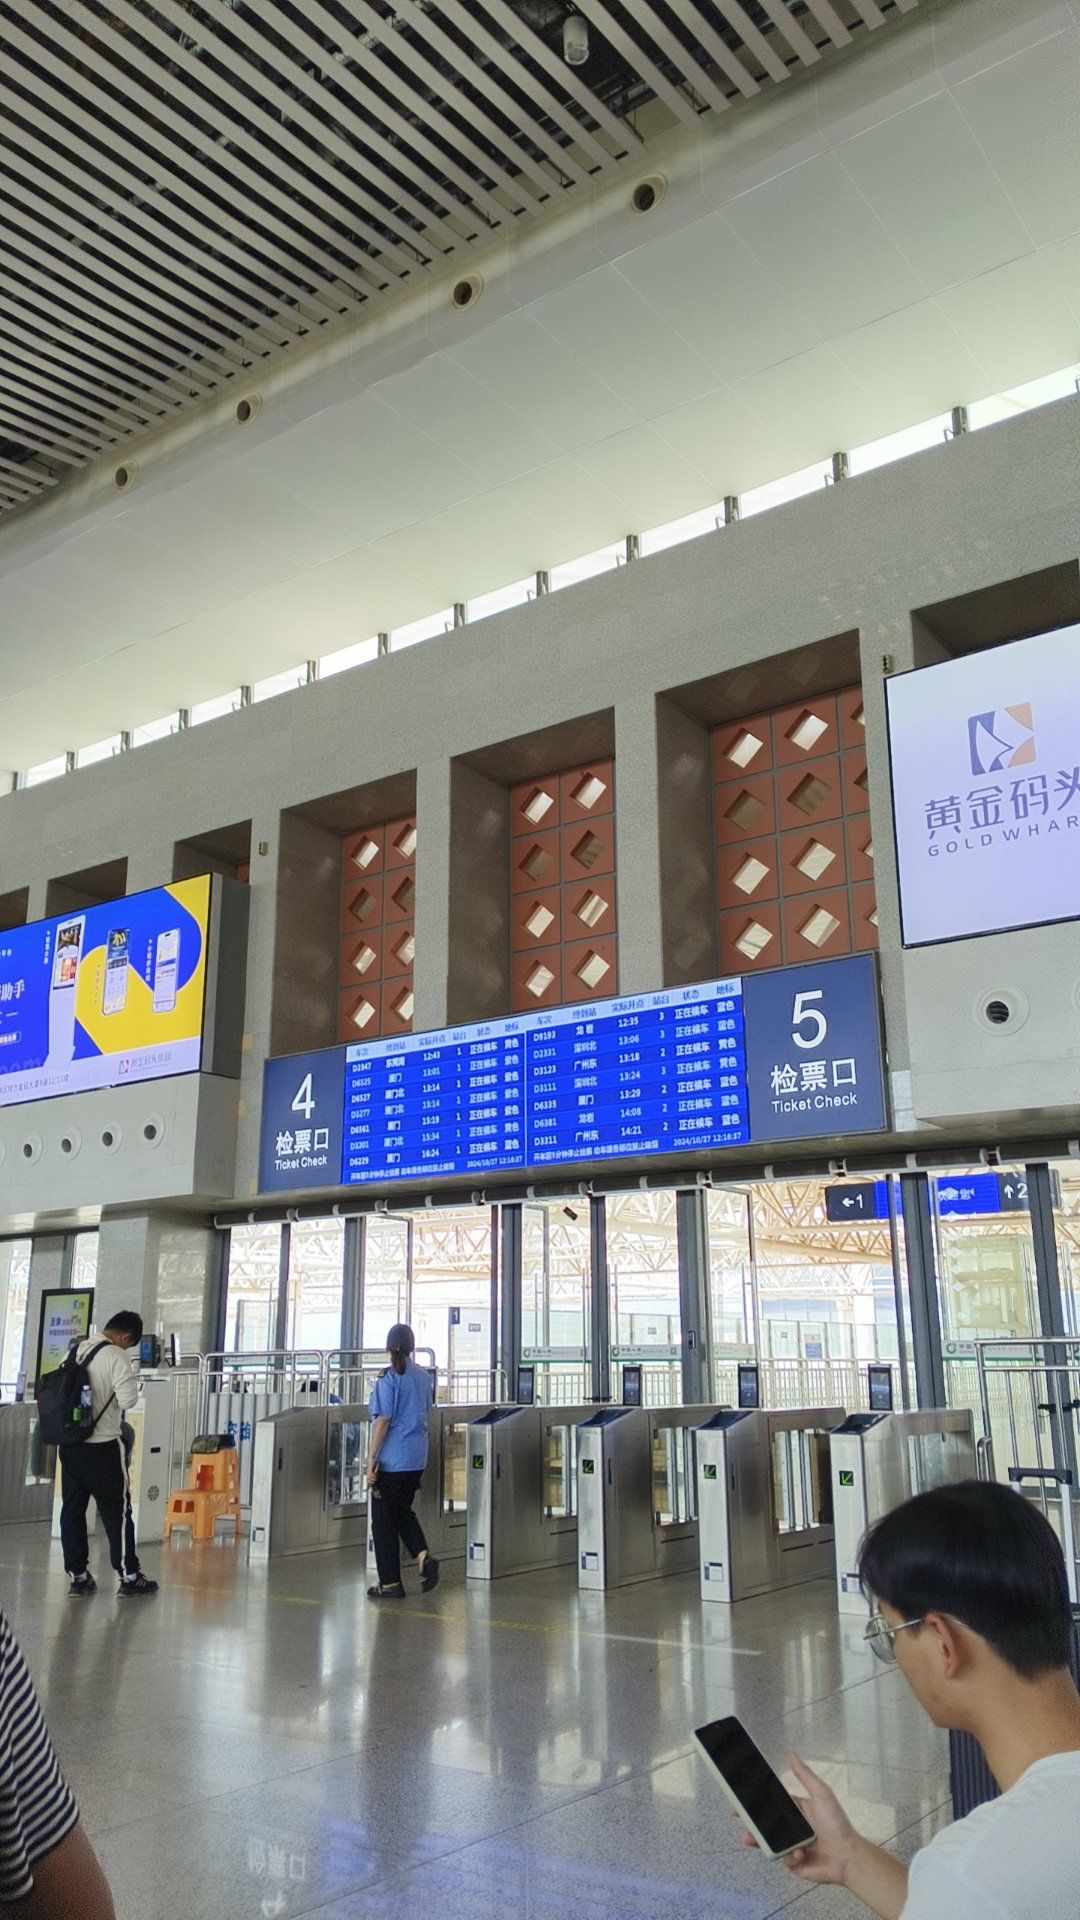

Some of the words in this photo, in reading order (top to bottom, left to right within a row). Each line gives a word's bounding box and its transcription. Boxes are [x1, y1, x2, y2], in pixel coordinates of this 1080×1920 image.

[924, 767, 1080, 840] 黄金码头
[928, 834, 992, 856] GOLD
[1002, 816, 1080, 841] WHAR
[536, 1016, 553, 1026] 车次
[611, 999, 645, 1013] 实际开点
[652, 995, 670, 1006] 站台
[682, 990, 700, 1001] 状态
[716, 983, 735, 995] 地标
[792, 990, 827, 1049] 5
[533, 1031, 556, 1042] D9193
[618, 1017, 639, 1028] 12:35
[659, 1012, 665, 1021] 3
[674, 1005, 709, 1020] 正在候车
[716, 1001, 735, 1013] 蓝色
[469, 1042, 498, 1055] 正在候车
[533, 1048, 557, 1059] D2331
[618, 1035, 640, 1046] 13:06
[660, 1030, 665, 1039] 3
[675, 1024, 710, 1038] 正在候车
[717, 1019, 736, 1032] 蓝色
[469, 1058, 498, 1071] 正在候车
[533, 1065, 557, 1076] D3123
[618, 1052, 640, 1064] 13:18
[660, 1048, 666, 1057] 2
[675, 1042, 711, 1057] 正在候车
[718, 1038, 737, 1051] 黄色
[469, 1075, 498, 1088] 正在候车
[533, 1083, 557, 1094] D3111
[619, 1071, 641, 1082] 13:24
[661, 1067, 667, 1076] 3
[676, 1061, 711, 1075] 正在候车
[719, 1057, 738, 1069] 黄色
[770, 1058, 857, 1096] 检票口
[292, 1072, 316, 1120] 4
[456, 1096, 461, 1105] 1
[469, 1091, 498, 1104] 正在候车
[533, 1100, 557, 1111] D6335
[619, 1089, 641, 1100] 13:29
[661, 1085, 667, 1094] 2
[677, 1079, 712, 1094] 正在候车
[719, 1076, 739, 1088] 蓝色
[772, 1098, 812, 1113] Ticket
[814, 1092, 858, 1109] Check
[469, 1108, 498, 1121] 正在候车
[534, 1118, 557, 1129] D6381
[620, 1107, 642, 1118] 14:08
[662, 1104, 668, 1113] 2
[678, 1098, 713, 1112] 正在候车
[720, 1095, 740, 1107] 蓝色
[276, 1128, 330, 1156] 检票口
[469, 1125, 498, 1138] 正在候车
[534, 1136, 558, 1147] D3311
[620, 1126, 643, 1137] 14:21
[662, 1122, 669, 1131] 2
[678, 1117, 714, 1131] 正在候车
[721, 1114, 741, 1126] 蓝色
[673, 1135, 712, 1147] 2024/10/27
[274, 1160, 300, 1171] Ticket
[300, 1154, 328, 1168] Check
[456, 1146, 461, 1155] 1
[469, 1142, 498, 1155] 正在候车
[856, 1194, 864, 1210] 1
[1018, 1182, 1029, 1199] 2
